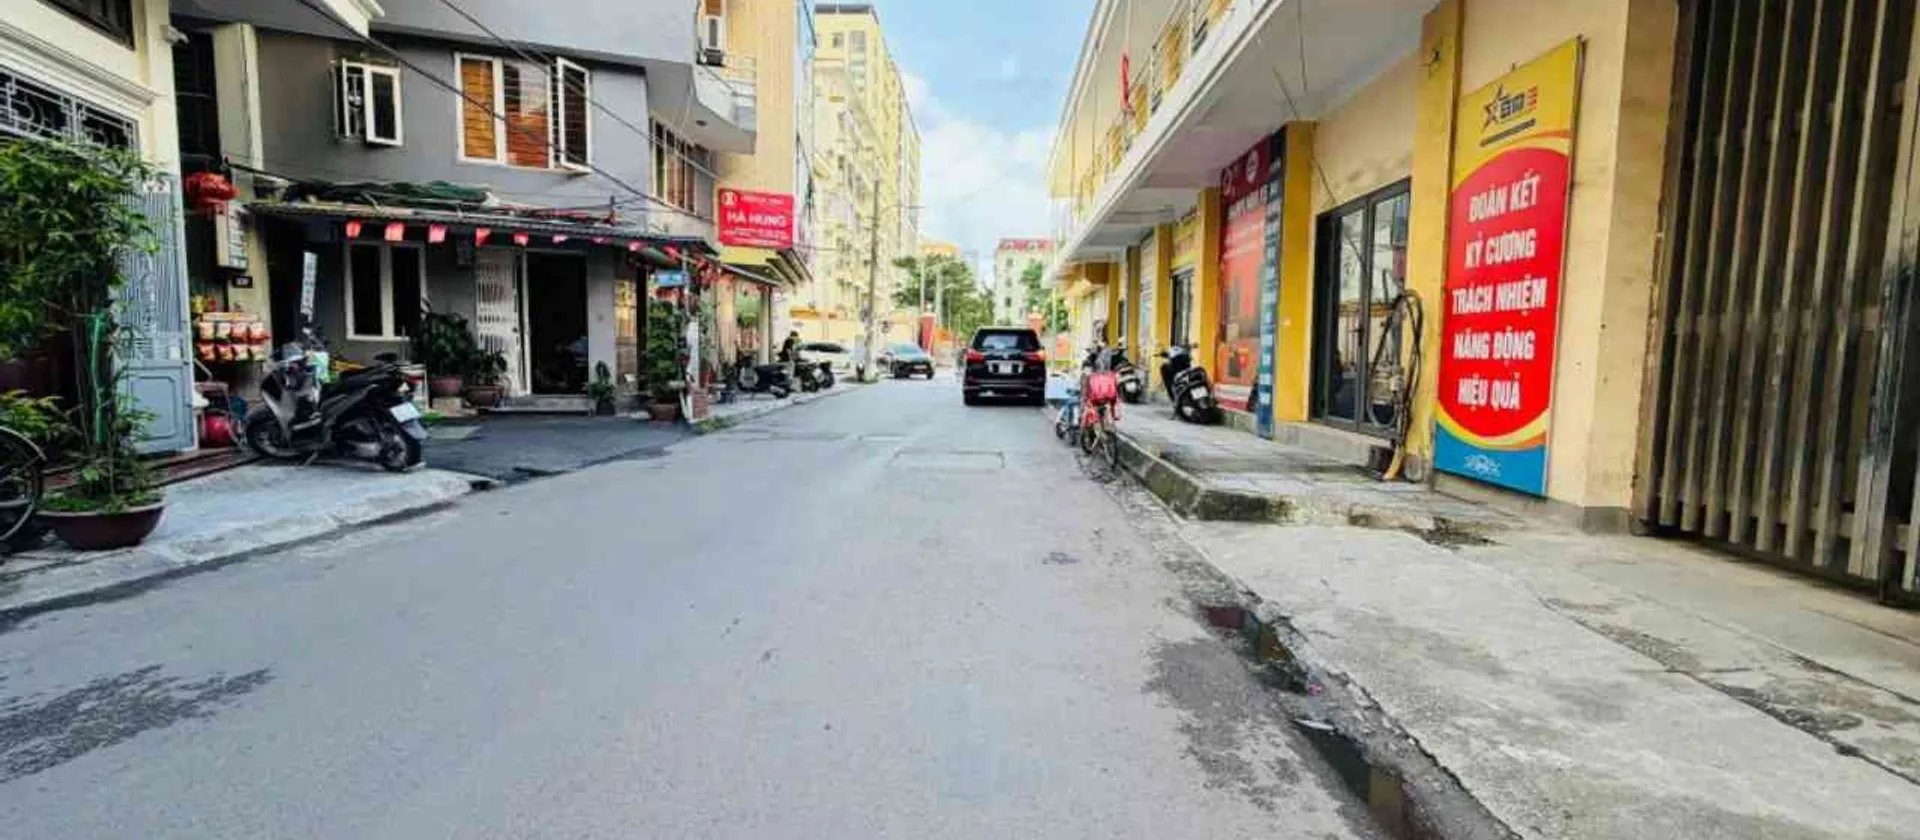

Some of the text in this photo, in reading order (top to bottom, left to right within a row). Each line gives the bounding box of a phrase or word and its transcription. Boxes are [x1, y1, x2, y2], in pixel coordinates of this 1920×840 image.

[1510, 168, 1540, 211] KẾT
[1452, 273, 1547, 316] TRÁCH NHIỆM
[1490, 372, 1520, 411] QUẢ
